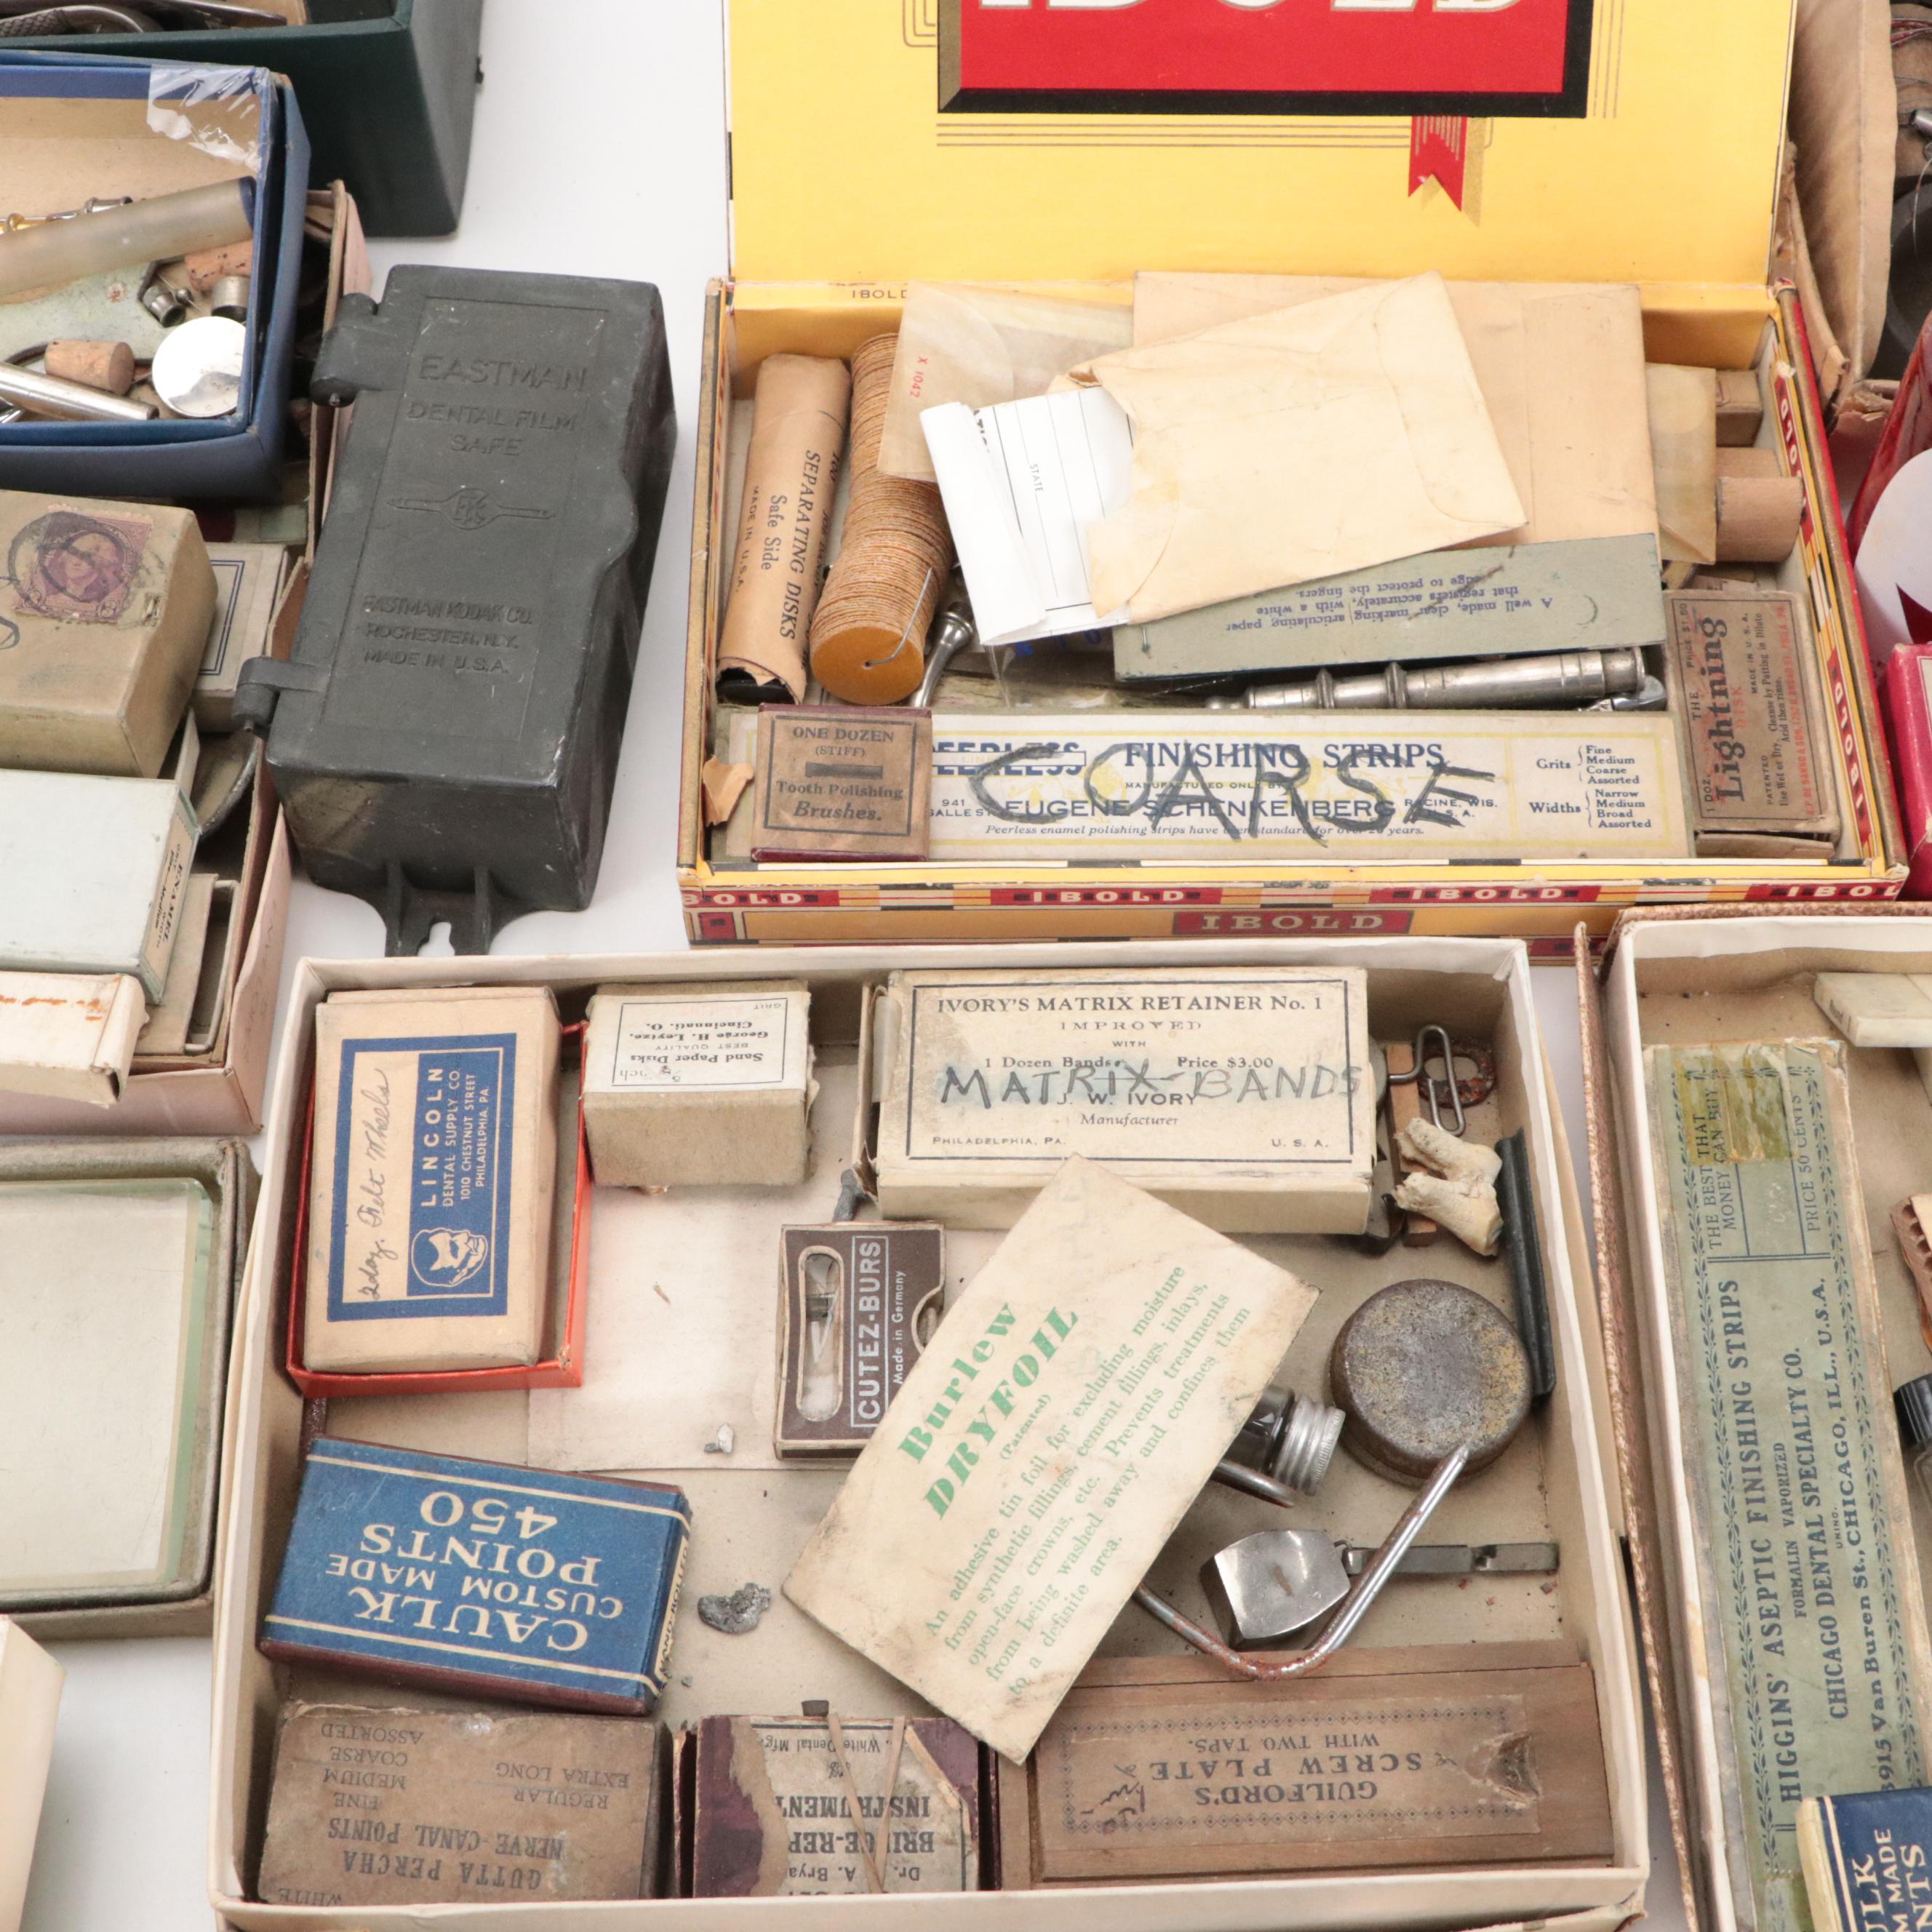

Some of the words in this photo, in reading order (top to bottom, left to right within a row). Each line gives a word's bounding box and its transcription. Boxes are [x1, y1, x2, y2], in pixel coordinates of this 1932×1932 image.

[418, 356, 588, 394] EASTMAN
[909, 370, 925, 398] 1042
[406, 399, 505, 426] DENTAL
[514, 410, 575, 431] FILM
[450, 434, 522, 456] SAFE
[1029, 463, 1045, 493] STATE
[768, 496, 787, 529] Safe
[790, 451, 821, 573] SEPARATING
[761, 537, 781, 570] Side
[1296, 584, 1343, 600] fingers.
[1353, 591, 1422, 609] accurately,
[1376, 578, 1423, 594] protect
[1493, 586, 1518, 597] that
[362, 594, 440, 617] EASTMAN
[442, 601, 504, 623] KODAK
[778, 580, 802, 639] DISKS
[1256, 604, 1292, 617] white
[1315, 601, 1344, 612] with
[1353, 606, 1409, 623] marking
[1505, 598, 1531, 611] well
[1226, 618, 1261, 632] paper
[1272, 612, 1344, 630] articulating
[1685, 639, 1694, 668] PRICE
[1689, 690, 1702, 720] THE
[1698, 618, 1744, 800] Lightning
[1731, 685, 1747, 730] DISK
[793, 726, 828, 738] ONE
[834, 729, 893, 742] DOZEN
[815, 745, 865, 757] (STIFF)
[1125, 742, 1299, 768] FINISHING
[1323, 743, 1442, 768] STRIPS
[1536, 759, 1570, 768] Grits
[1586, 745, 1610, 754] Fine
[1587, 756, 1634, 764] Medium
[1586, 766, 1626, 774] Coarse
[1588, 775, 1640, 783] Assorted
[776, 780, 822, 794] Tooth
[829, 783, 903, 801] Polishing
[968, 739, 1495, 847] COARSE
[1596, 789, 1638, 797] Narrow
[792, 800, 882, 821] Brushes.
[1006, 799, 1130, 816] EUGENE
[1530, 803, 1580, 813] Widths
[1597, 799, 1645, 807] Medium
[1597, 809, 1632, 818] Broad
[986, 825, 1037, 834] Peerless
[1041, 826, 1085, 834] enamel
[1088, 826, 1146, 836] polishing
[1598, 819, 1651, 827] Assorted
[1201, 915, 1384, 930] IBOLD
[938, 998, 1029, 1013] IVORY'S
[1037, 997, 1133, 1011] MATRIX
[1142, 997, 1260, 1010] RETAINER
[1270, 996, 1305, 1010] No.
[1060, 1021, 1202, 1030] IMPROVED
[631, 1055, 668, 1063] Disks
[675, 1053, 718, 1062] Paper
[726, 1053, 762, 1062] Sand
[1002, 1058, 1052, 1068] Dozen
[1177, 1056, 1218, 1068] Price
[1228, 1057, 1273, 1068] $3.00
[464, 1073, 476, 1109] STREET
[940, 1058, 1159, 1109] MATRIX
[1194, 1064, 1362, 1103] BANDS
[361, 1069, 390, 1159] Wheels
[1127, 1093, 1199, 1105] IVORY
[1705, 1086, 1722, 1120] BUY
[444, 1096, 459, 1147] SUPPLY
[1080, 1113, 1178, 1126] Manufacturer
[1790, 1095, 1807, 1148] CENTS
[422, 1069, 442, 1206] LINCOLN
[461, 1115, 474, 1171] CHESTNUT
[1693, 1114, 1709, 1158] THAT
[1711, 1129, 1727, 1164] CAN
[442, 1154, 457, 1207] DENTAL
[460, 1175, 472, 1200] 1010
[1699, 1163, 1717, 1207] BEST
[356, 1168, 386, 1228] Felt
[1717, 1172, 1736, 1230] MONEY
[1801, 1181, 1820, 1231] PRICE
[1706, 1215, 1721, 1250] THE
[892, 1272, 906, 1322] Germany
[1718, 1280, 1747, 1368] STRIPS
[891, 1347, 904, 1384] Made
[898, 1302, 1018, 1464] Burlew
[923, 1306, 1079, 1520] DRYFOIL
[950, 1525, 1005, 1600] adhesive
[1074, 1344, 1133, 1417] excluding
[1132, 1267, 1183, 1336] moisture
[1788, 1384, 1820, 1506] SPECIALTY
[1731, 1379, 1768, 1522] FINISHING
[944, 1608, 979, 1650] from
[978, 1525, 1031, 1603] synthetic
[1029, 1465, 1081, 1524] fillings,
[1077, 1401, 1122, 1456] cement
[1119, 1341, 1167, 1395] fillings,
[969, 1581, 1031, 1666] open-face
[1104, 1388, 1164, 1456] Prevents
[1164, 1295, 1228, 1381] treatments
[986, 1640, 1021, 1680] from
[1015, 1584, 1058, 1632] being
[1058, 1513, 1103, 1574] washed
[1104, 1464, 1139, 1507] away
[1139, 1424, 1167, 1458] and
[1168, 1356, 1216, 1420] confines
[1216, 1309, 1250, 1347] them
[1773, 1440, 1796, 1527] VAPORIZED
[1833, 1417, 1861, 1545] CHICAGO,
[420, 1493, 556, 1538] 450
[361, 1525, 598, 1586] POINTS
[1805, 1513, 1835, 1608] DENTAL
[326, 1555, 435, 1590] MADE
[1785, 1538, 1808, 1618] FORMALIN
[463, 1577, 622, 1618] CUSTOM
[1752, 1539, 1784, 1656] ASEPTIC
[351, 1587, 586, 1650] CAULK
[1859, 1596, 1880, 1673] Buren
[1819, 1615, 1848, 1718] CHICAGO
[1869, 1679, 1886, 1731] Van
[322, 1719, 424, 1749] ASSORTED
[844, 1738, 880, 1753] White
[1189, 1739, 1249, 1753] TAPS.
[1263, 1736, 1310, 1750] TWO
[1325, 1734, 1379, 1747] WITH
[1768, 1673, 1803, 1802] HIGGINS'
[329, 1746, 408, 1769] COARSE
[494, 1762, 551, 1783] LONG
[1151, 1759, 1270, 1781] PLATE
[1301, 1753, 1421, 1775] SCREW
[323, 1768, 407, 1792] MEDIUM
[560, 1765, 630, 1789] EXTRA
[1196, 1778, 1378, 1805] GUILFORD'S
[514, 1781, 608, 1811] REGULAR
[327, 1814, 401, 1846] POINTS
[413, 1824, 481, 1852] CANAL
[345, 1848, 442, 1881] PERCHA
[458, 1859, 542, 1891] GUTTA
[893, 1867, 919, 1881] Dr.
[1875, 1827, 1902, 1904] MADE
